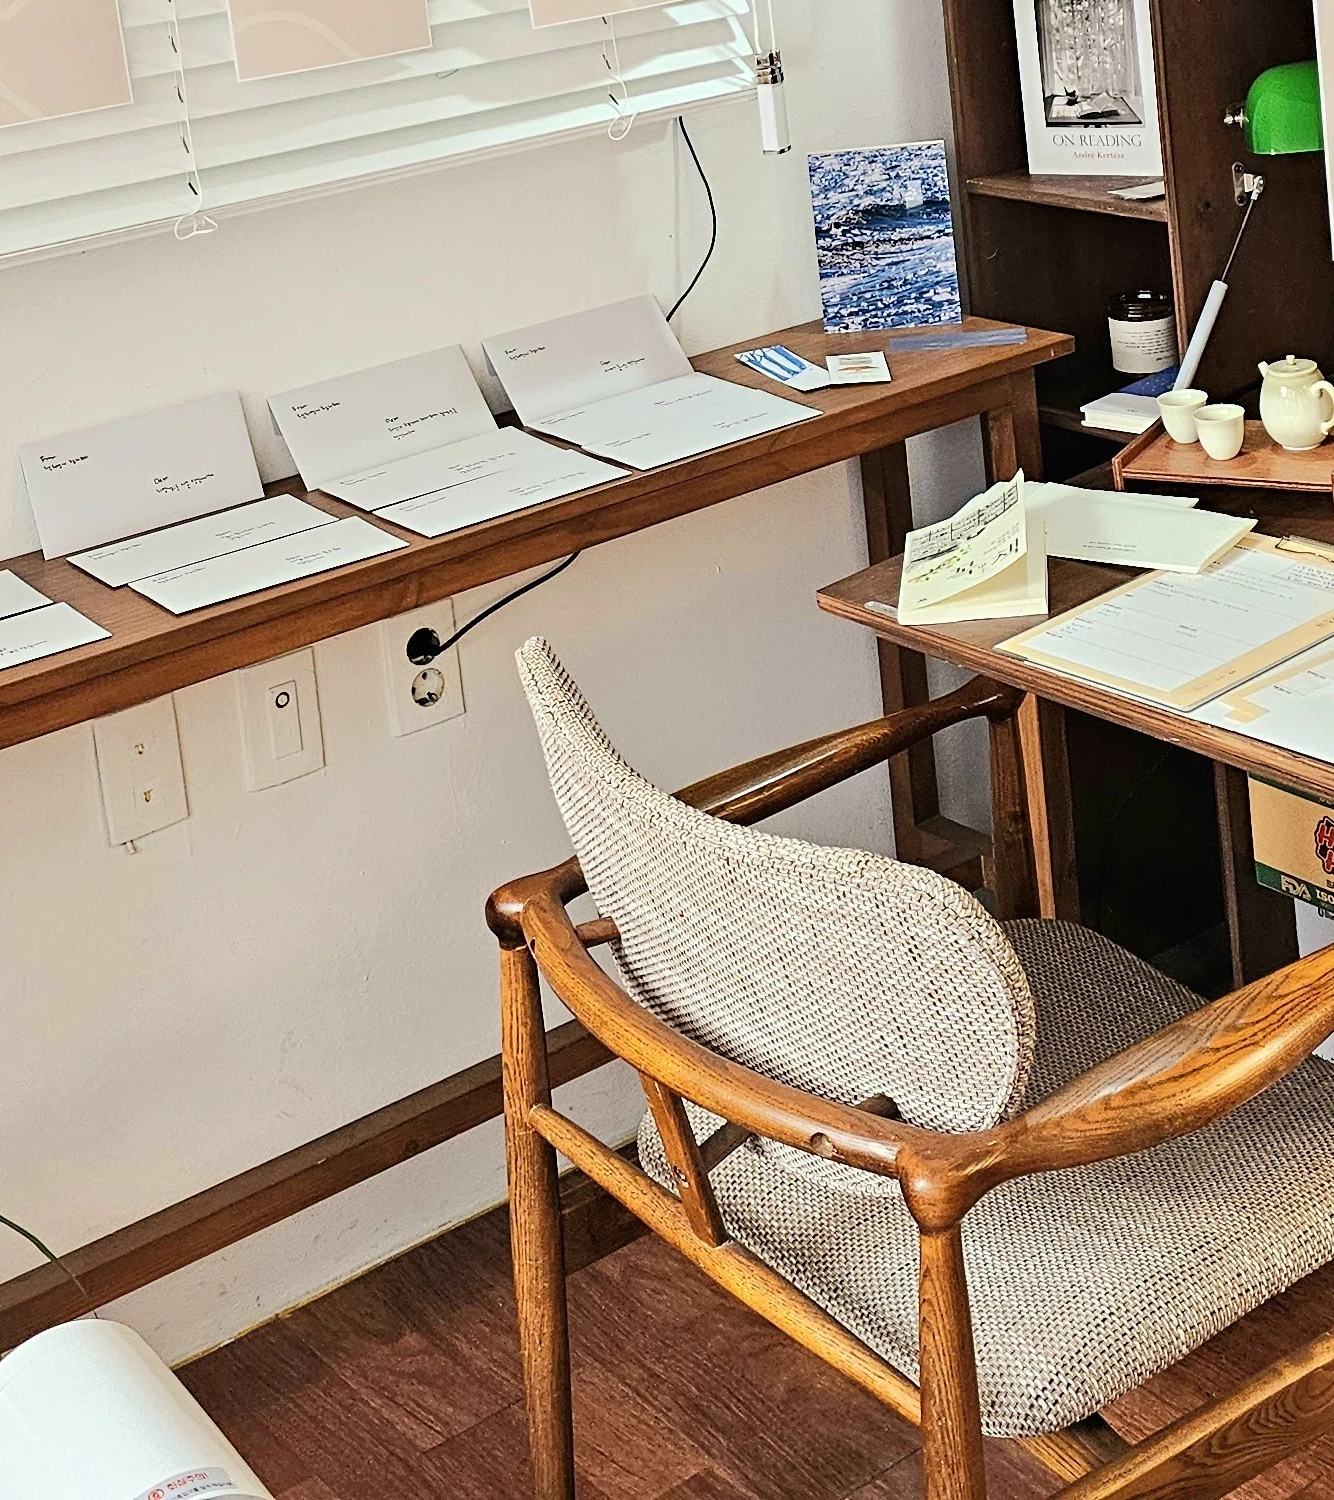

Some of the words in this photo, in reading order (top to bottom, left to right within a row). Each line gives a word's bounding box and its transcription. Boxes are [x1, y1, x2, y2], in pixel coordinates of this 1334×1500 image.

[1052, 134, 1075, 146] ON
[1079, 134, 1142, 147] READING
[1281, 875, 1311, 901] FDA
[1315, 889, 1334, 904] ISO
